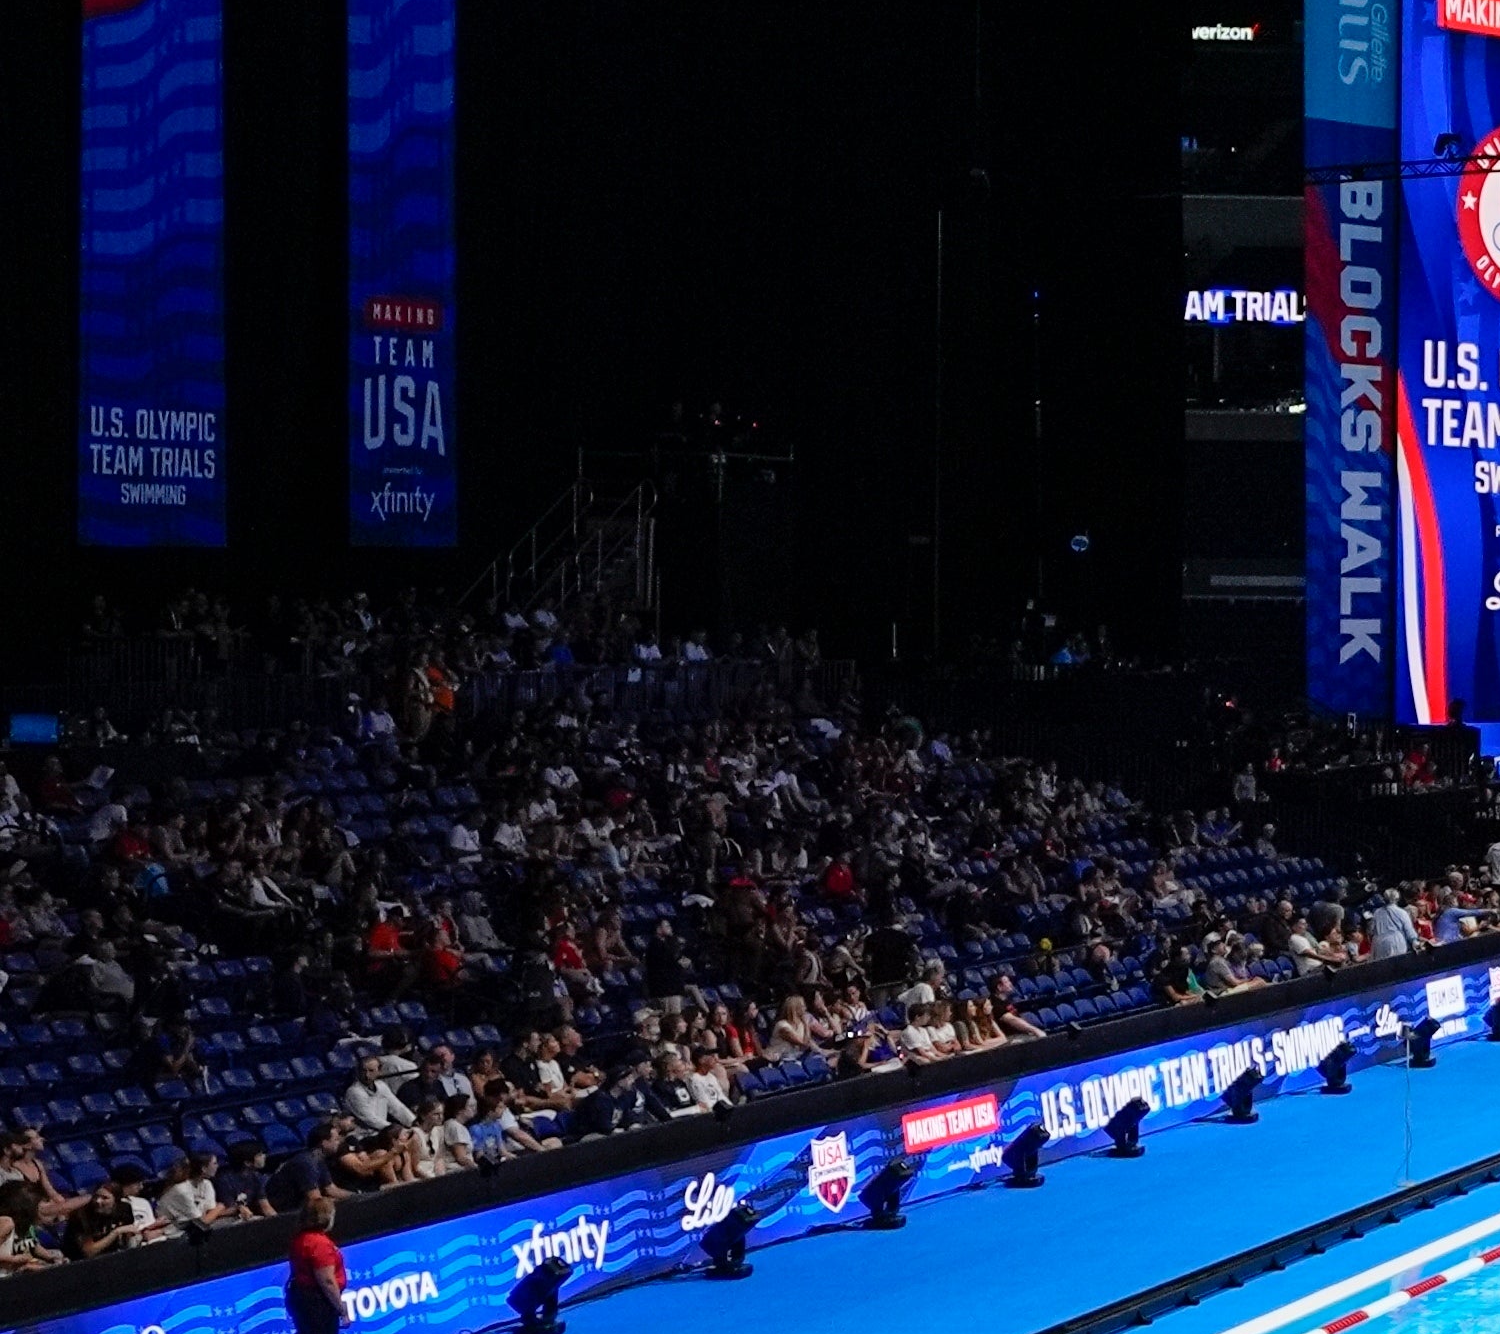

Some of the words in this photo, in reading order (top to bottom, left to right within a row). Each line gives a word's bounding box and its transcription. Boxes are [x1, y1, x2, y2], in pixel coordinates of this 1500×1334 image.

[1191, 24, 1254, 41] verizon
[1339, 173, 1383, 454] BLOCKS
[1422, 339, 1488, 392] U.S.
[89, 404, 130, 440] U.S.
[135, 407, 217, 444] OLYMPIC
[363, 373, 446, 457] USA
[89, 442, 145, 478] TEAM
[120, 481, 187, 507] SWIMMING
[1040, 1087, 1082, 1142] U.S.
[1159, 1047, 1208, 1108] TEAM
[906, 1110, 945, 1147] MAKING
[945, 1106, 974, 1138] TEAM
[973, 1099, 996, 1131] USA
[817, 1142, 843, 1168] USA
[342, 1270, 440, 1323] TOYOTA
